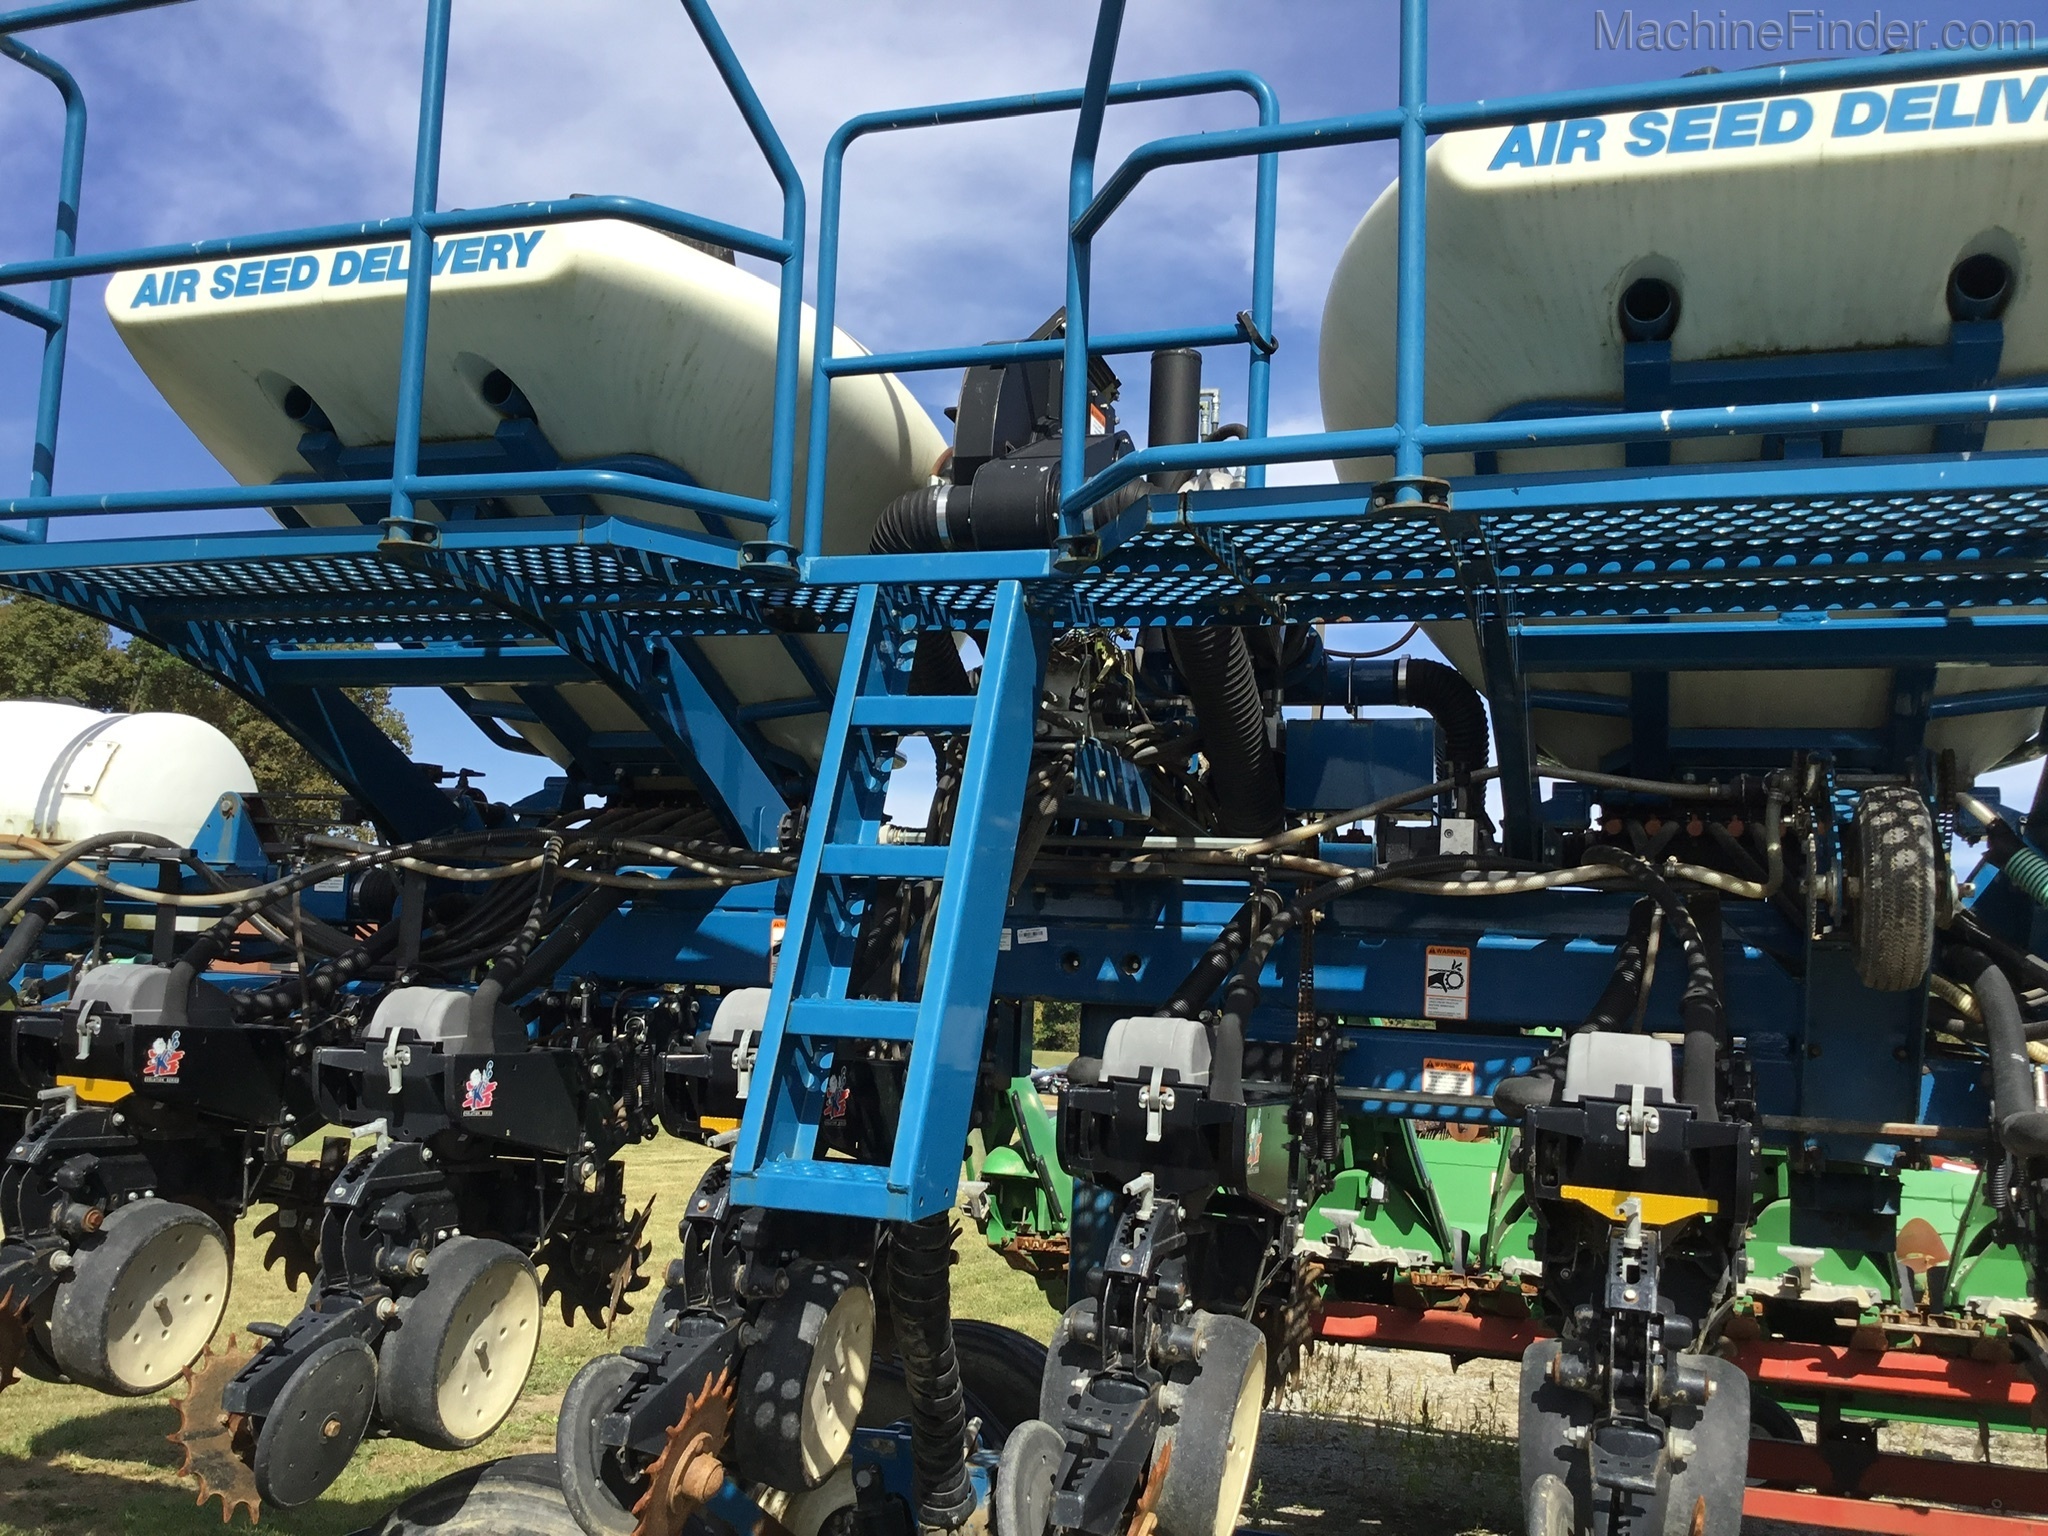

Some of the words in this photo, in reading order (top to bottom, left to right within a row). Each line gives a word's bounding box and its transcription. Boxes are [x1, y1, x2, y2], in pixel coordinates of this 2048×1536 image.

[1487, 118, 1606, 171] AIR
[1624, 98, 1815, 157] SEED
[1831, 75, 2048, 138] DELIV
[130, 268, 200, 309] AIR
[209, 255, 320, 300] SEED
[328, 230, 546, 287] DELVERY
[1436, 948, 1467, 956] WARNING
